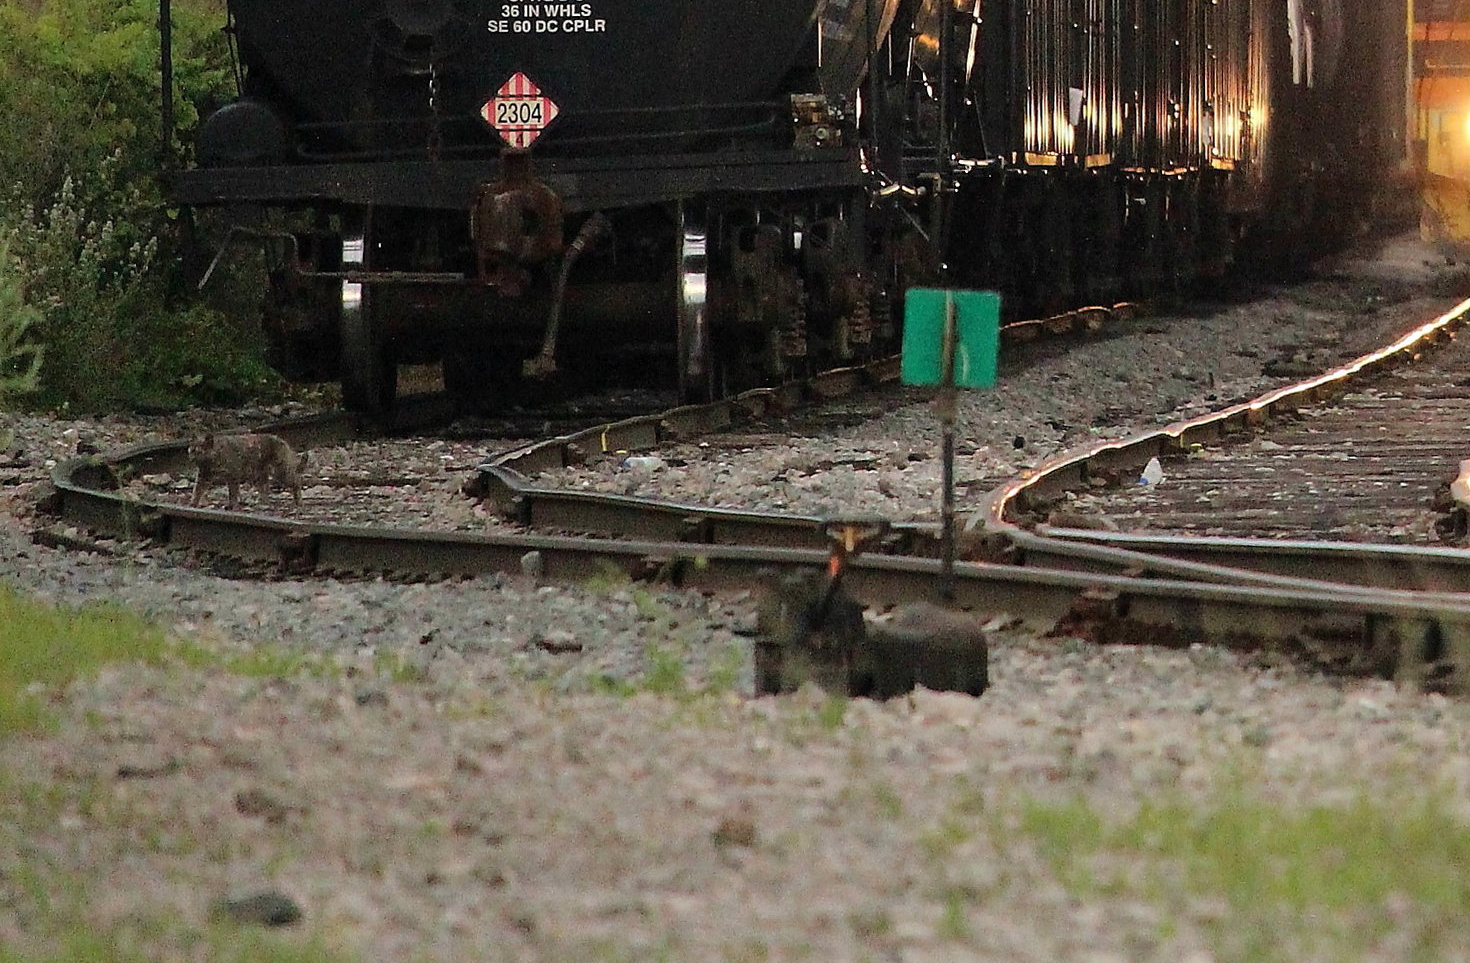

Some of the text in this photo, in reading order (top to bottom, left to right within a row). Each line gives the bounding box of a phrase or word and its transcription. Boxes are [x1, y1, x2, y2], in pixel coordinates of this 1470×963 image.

[501, 4, 592, 17] 36 IN WHLS
[488, 20, 606, 33] SE 60 DC CPLR
[497, 103, 542, 123] 2304
[516, 133, 524, 147] 4
